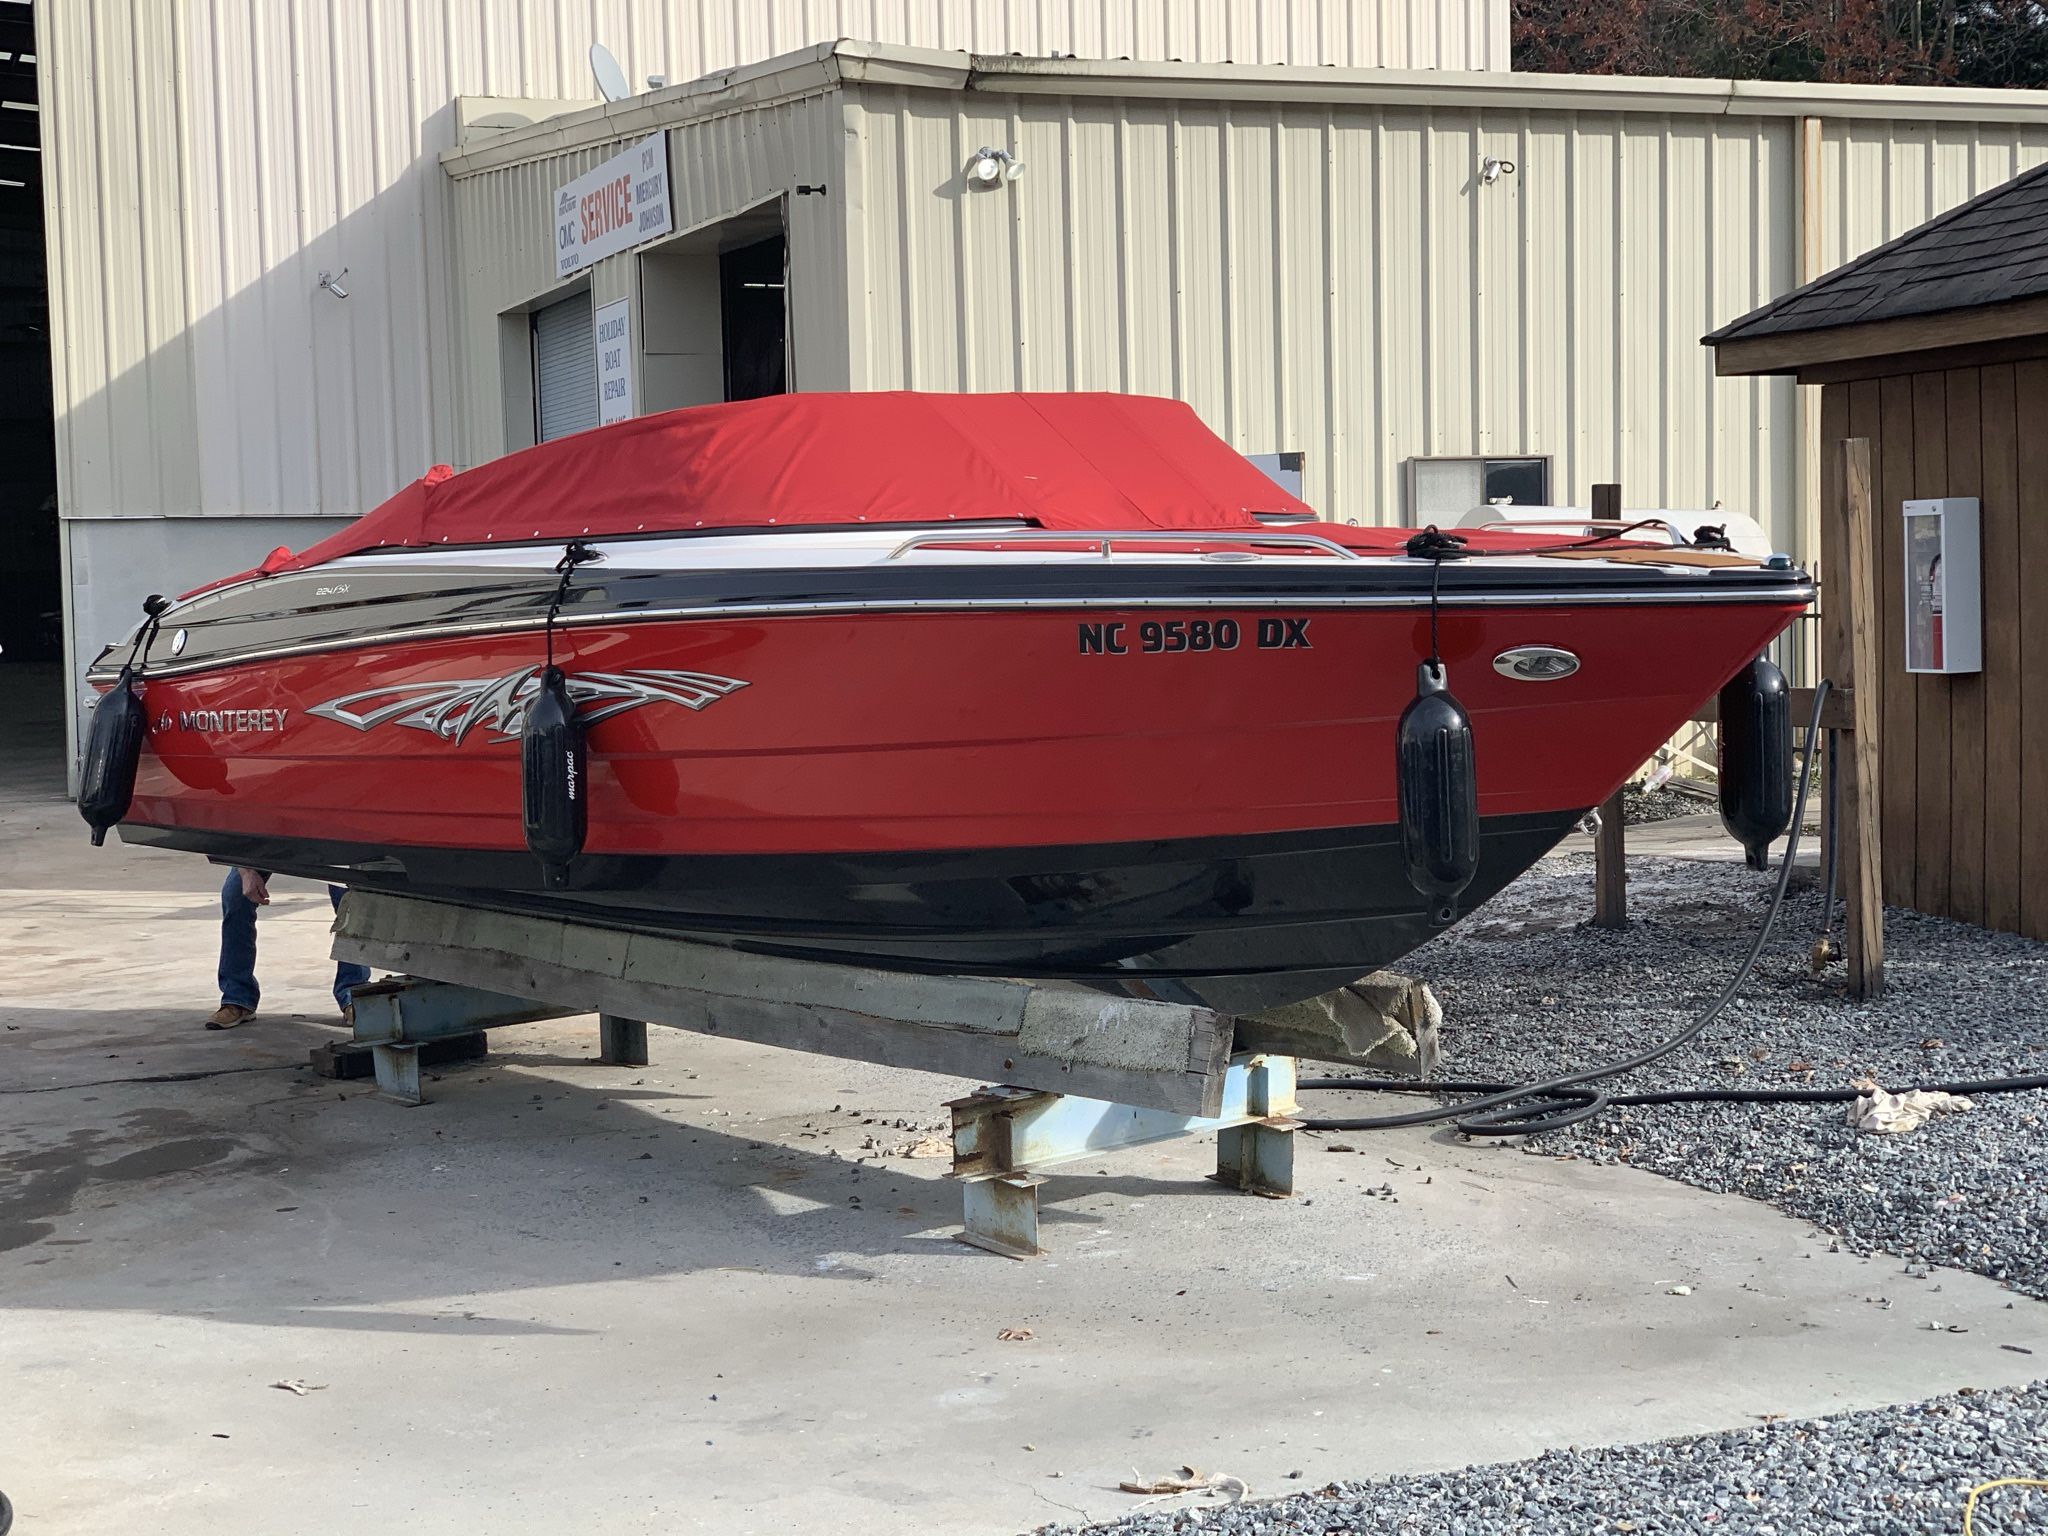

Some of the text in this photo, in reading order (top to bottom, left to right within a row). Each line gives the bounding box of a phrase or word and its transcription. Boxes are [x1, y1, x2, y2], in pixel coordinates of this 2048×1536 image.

[635, 172, 663, 205] MERCURY
[580, 174, 633, 245] SERVICE
[639, 202, 665, 233] JOHNSON
[559, 220, 576, 250] OMC
[560, 253, 579, 270] VOLVO
[599, 316, 626, 343] HOLIDAY
[604, 348, 621, 371] BOAT
[603, 378, 626, 401] REPAIR
[1078, 617, 1314, 656] NC 9580 DX
[180, 707, 289, 732] MONTEREY
[565, 750, 579, 801] marpac
